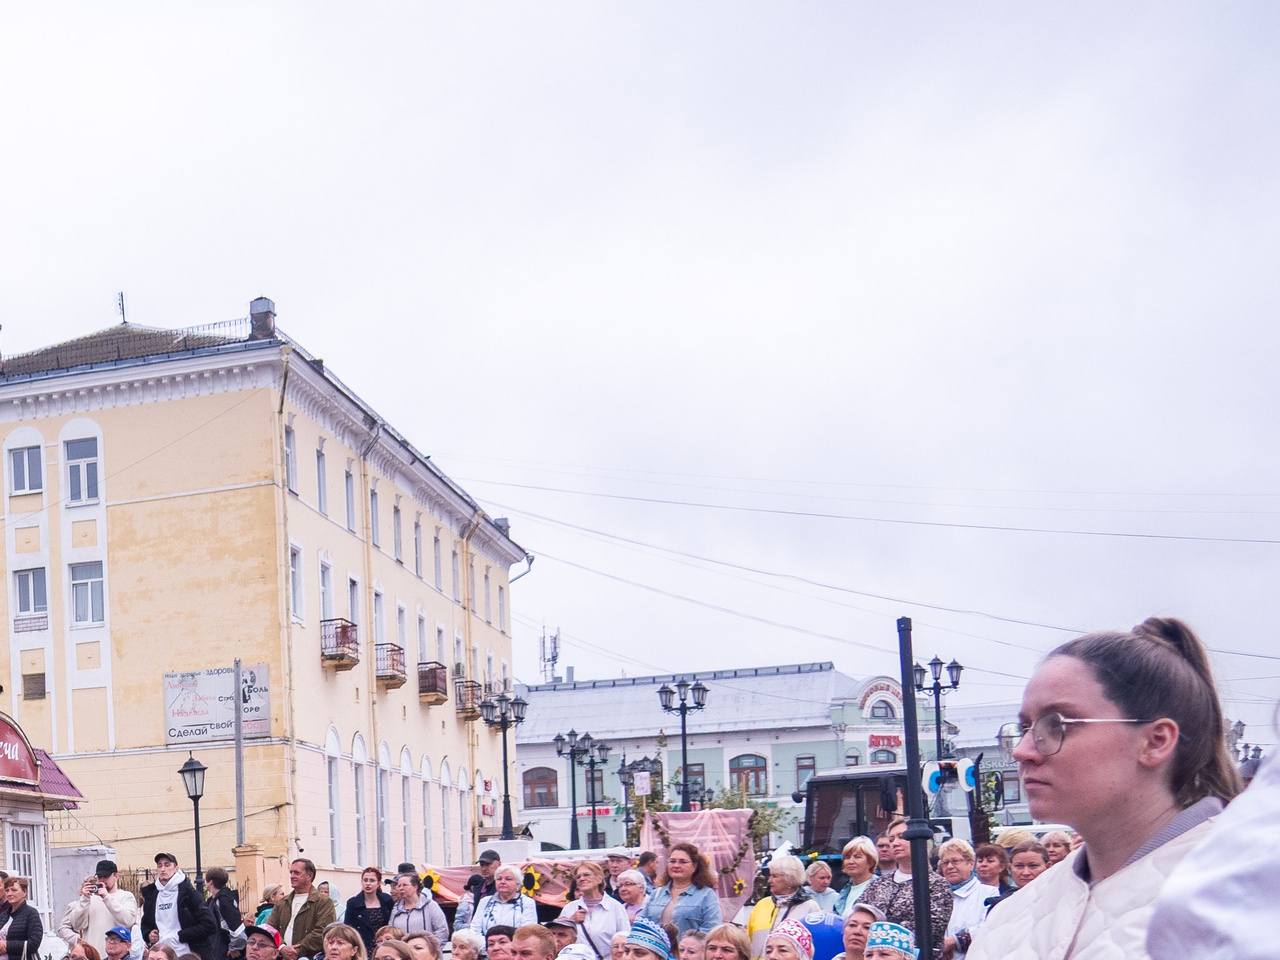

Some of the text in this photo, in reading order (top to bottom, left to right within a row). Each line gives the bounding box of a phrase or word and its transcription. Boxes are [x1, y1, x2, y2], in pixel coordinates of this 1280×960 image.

[206, 667, 235, 676] здоровь
[168, 727, 208, 738] Сделай
[209, 719, 233, 730] свой
